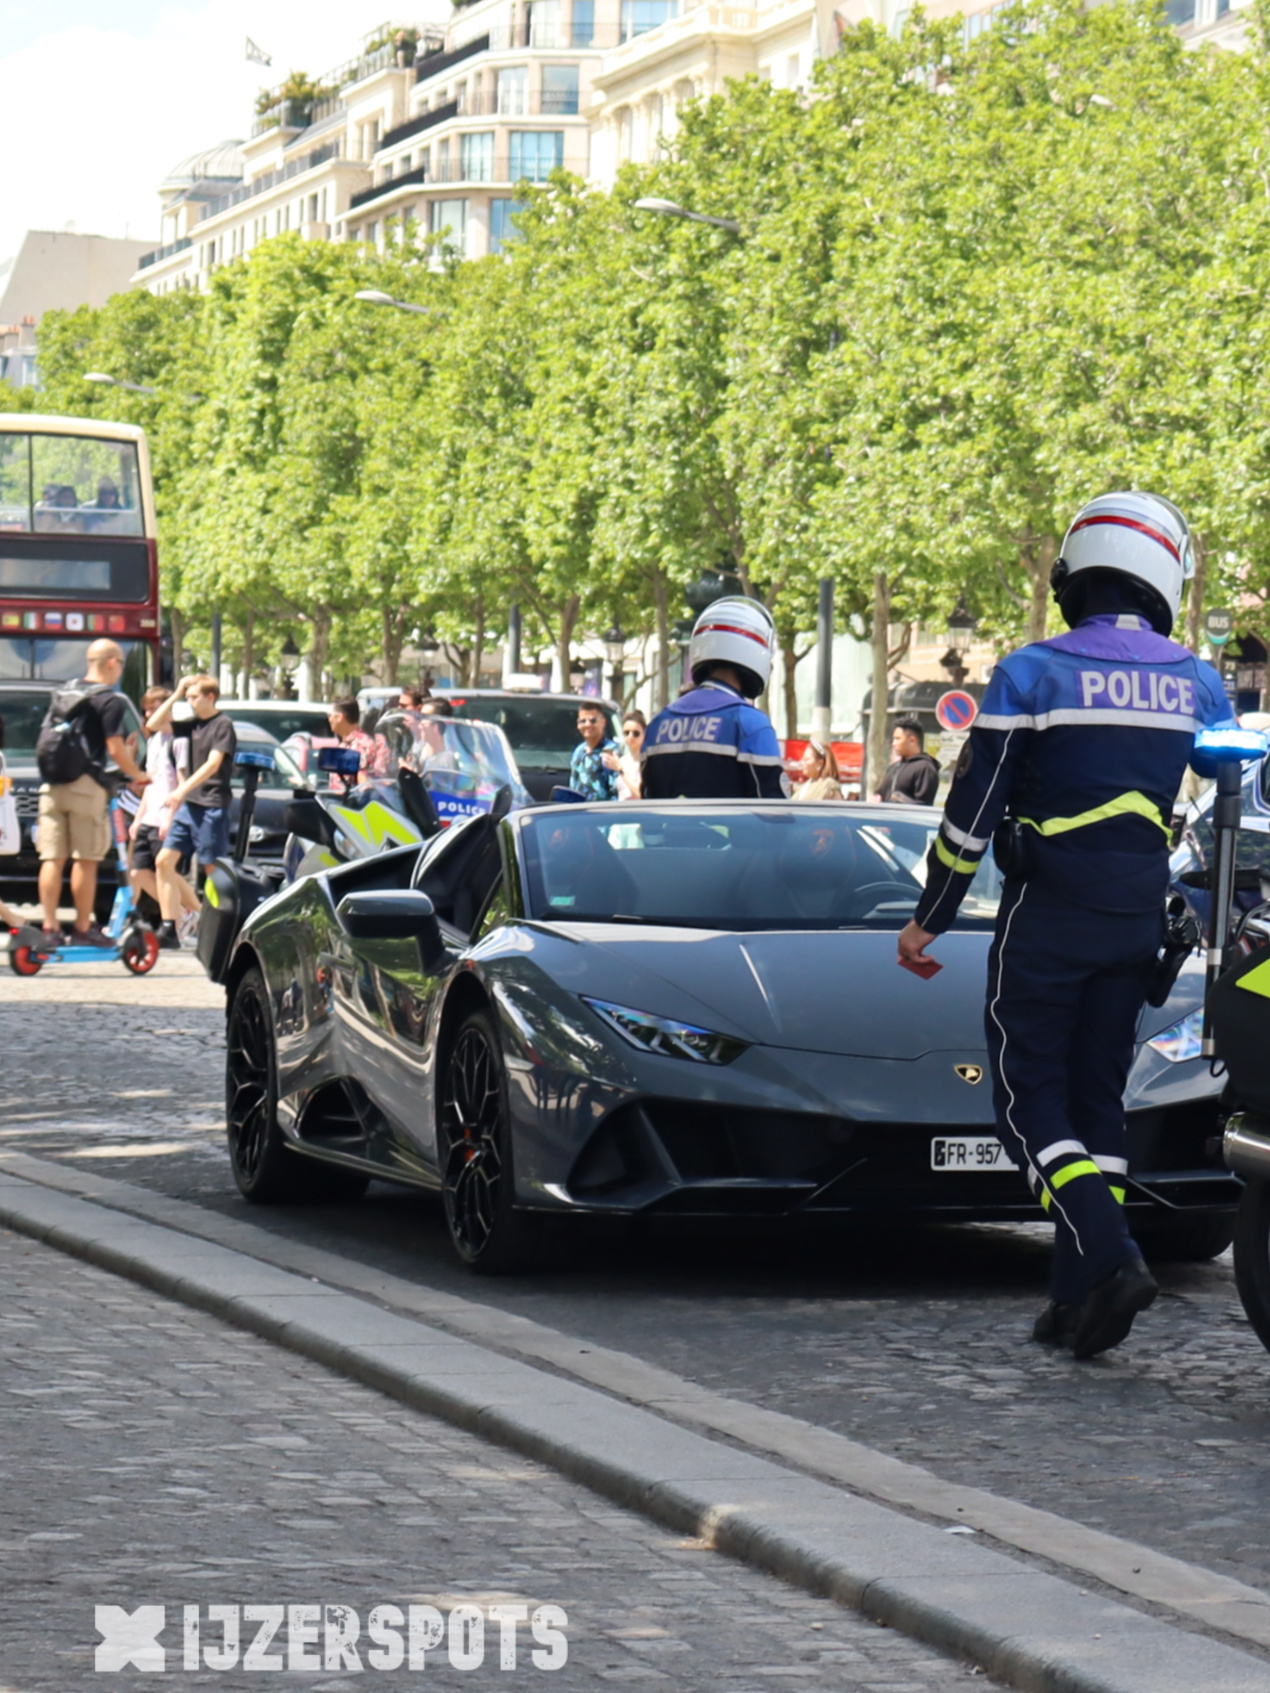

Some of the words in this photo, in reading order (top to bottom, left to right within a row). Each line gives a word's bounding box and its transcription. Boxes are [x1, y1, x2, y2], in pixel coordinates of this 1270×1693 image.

[1208, 615, 1230, 629] BUS
[1080, 670, 1195, 715] POLICE
[656, 716, 722, 744] POLICE
